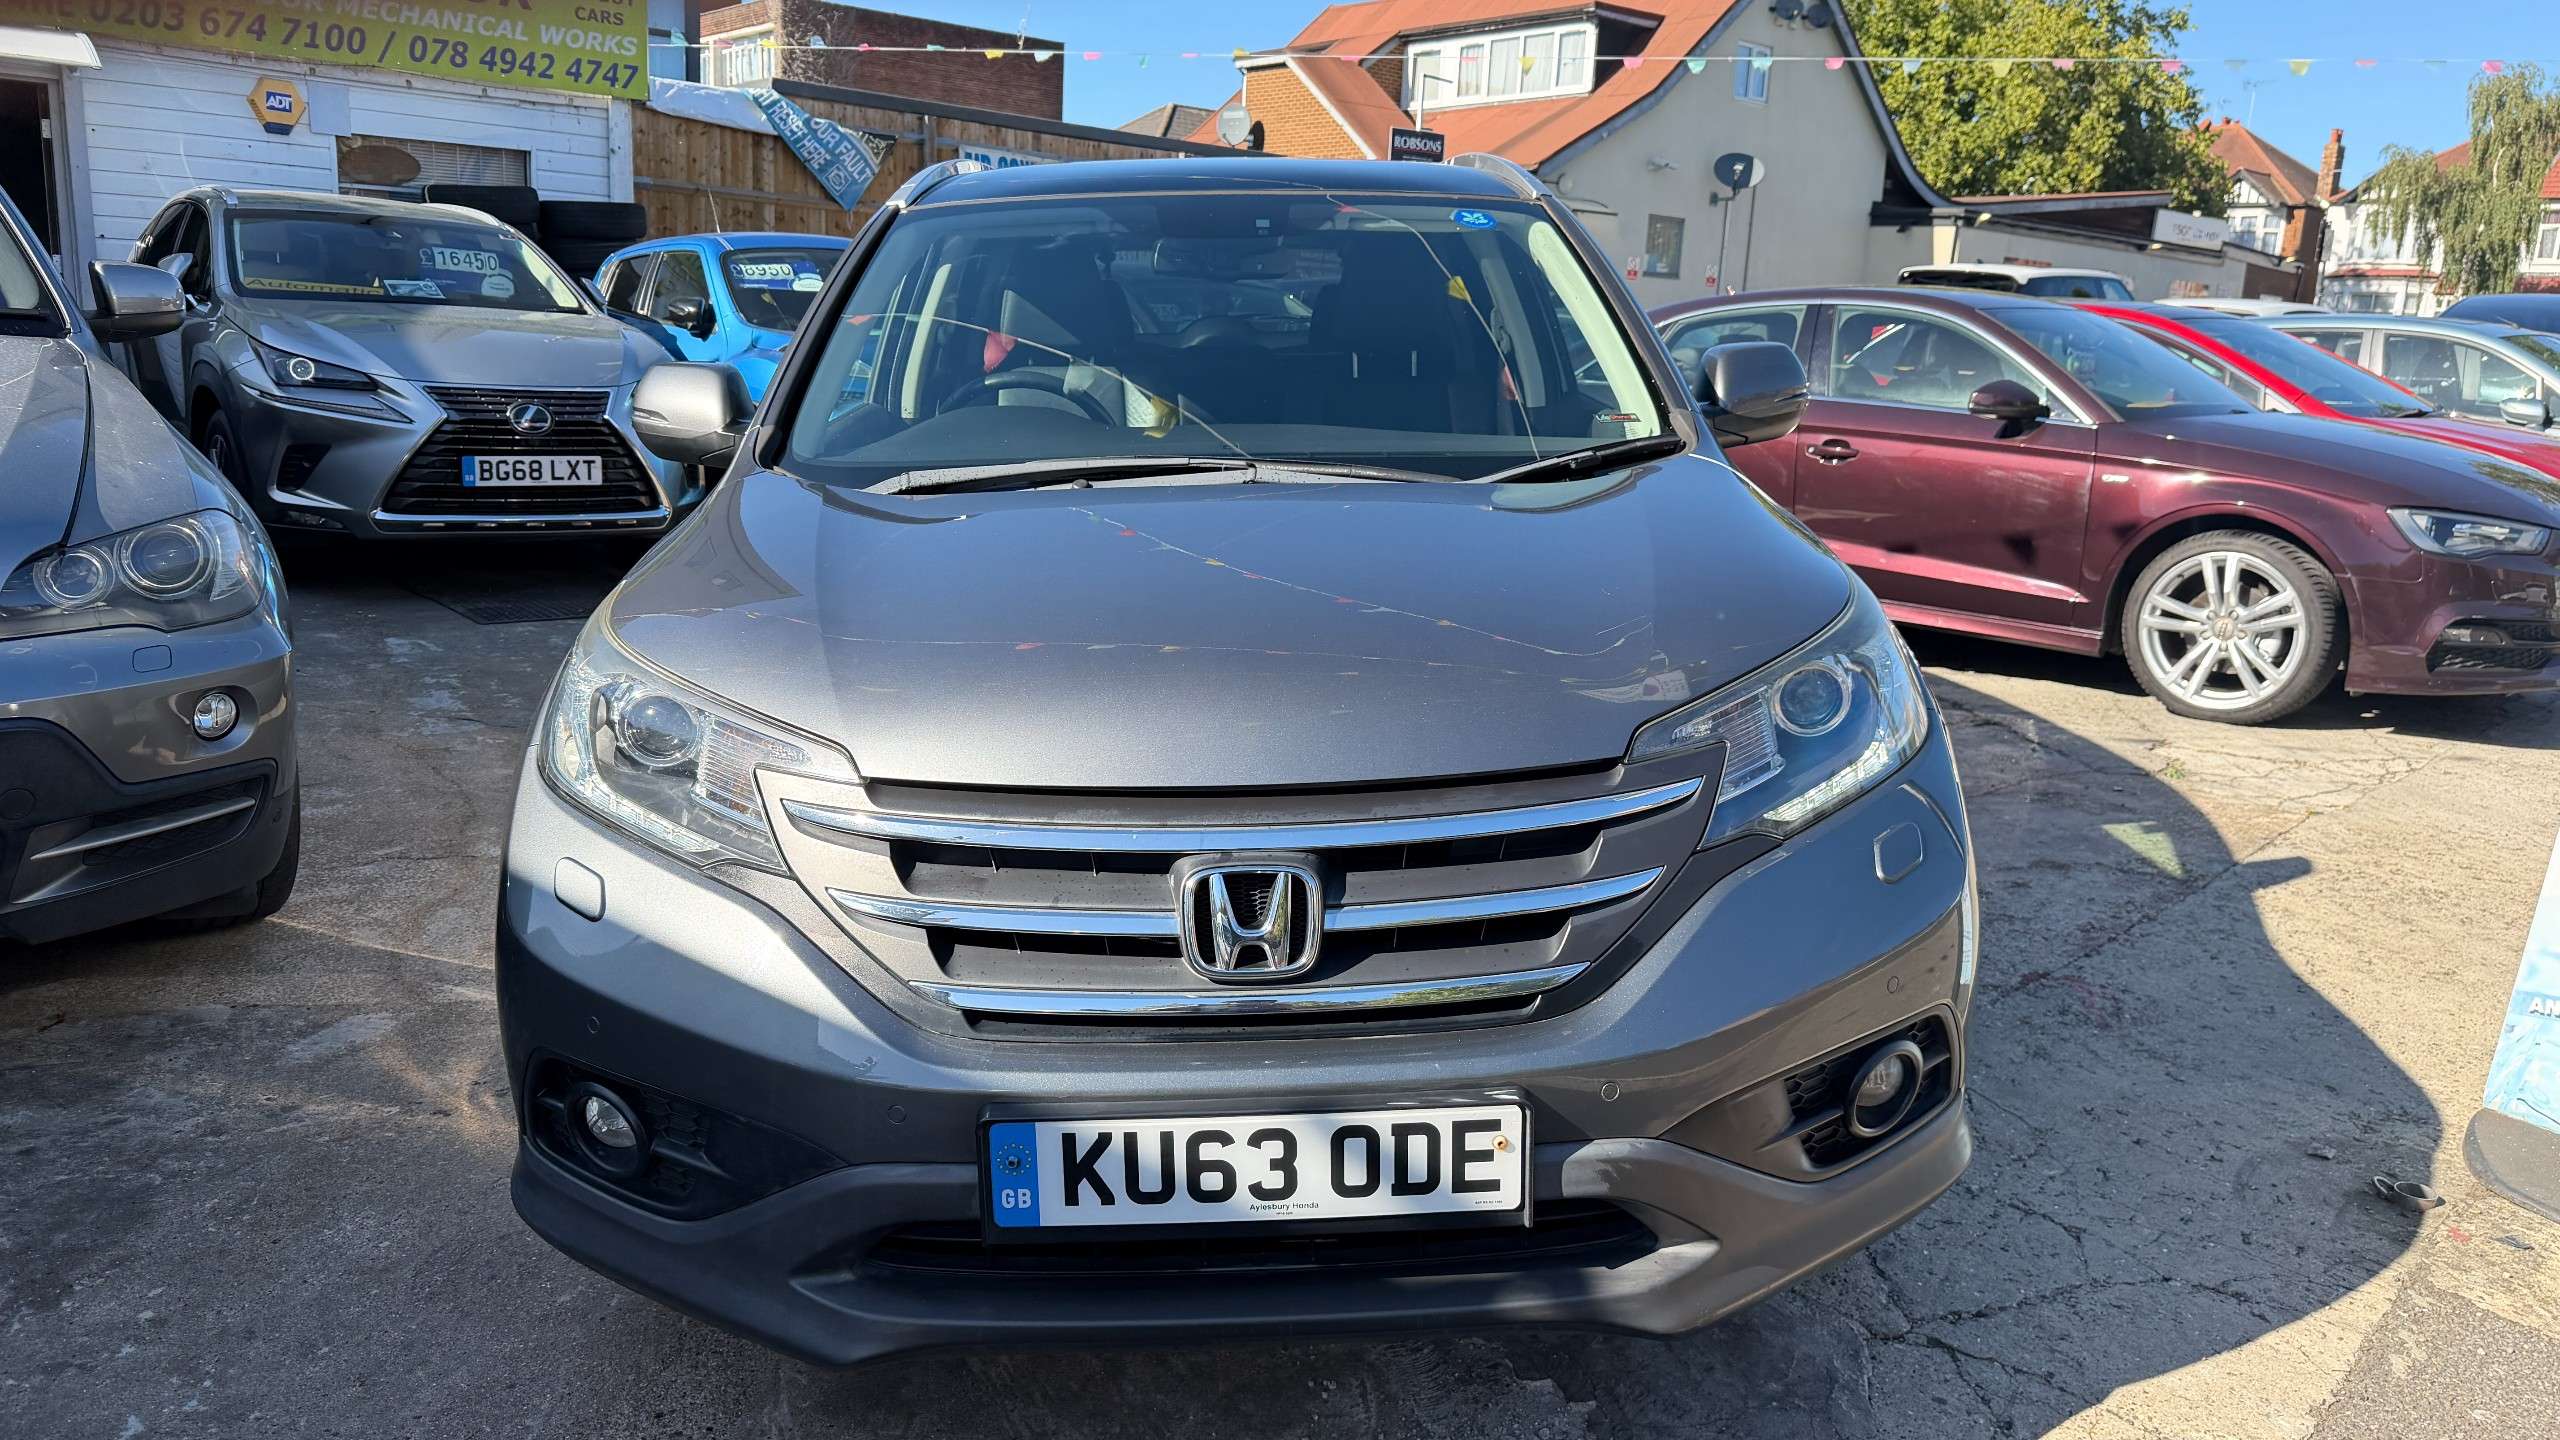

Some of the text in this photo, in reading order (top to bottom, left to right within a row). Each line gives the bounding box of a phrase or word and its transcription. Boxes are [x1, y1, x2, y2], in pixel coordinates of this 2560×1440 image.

[575, 6, 624, 26] CARS
[335, 0, 638, 56] MECHANICAL WORKS
[88, 0, 185, 31] 0203
[200, 7, 267, 42] 674
[281, 17, 367, 54] 7100
[377, 31, 396, 63] /
[409, 35, 469, 68] 078
[479, 46, 555, 80] 4942
[565, 58, 639, 89] 4747
[267, 94, 292, 110] ADT
[767, 101, 810, 141] RESET
[796, 136, 832, 170] HERE
[1393, 135, 1442, 153] ROBSONS
[835, 139, 874, 183] FAULT
[479, 460, 596, 481] BG68 LXT
[1062, 1118, 1501, 1207] KU63 ODE
[1001, 1188, 1031, 1209] GB
[1249, 1201, 1319, 1212] Aylesbury Honda
